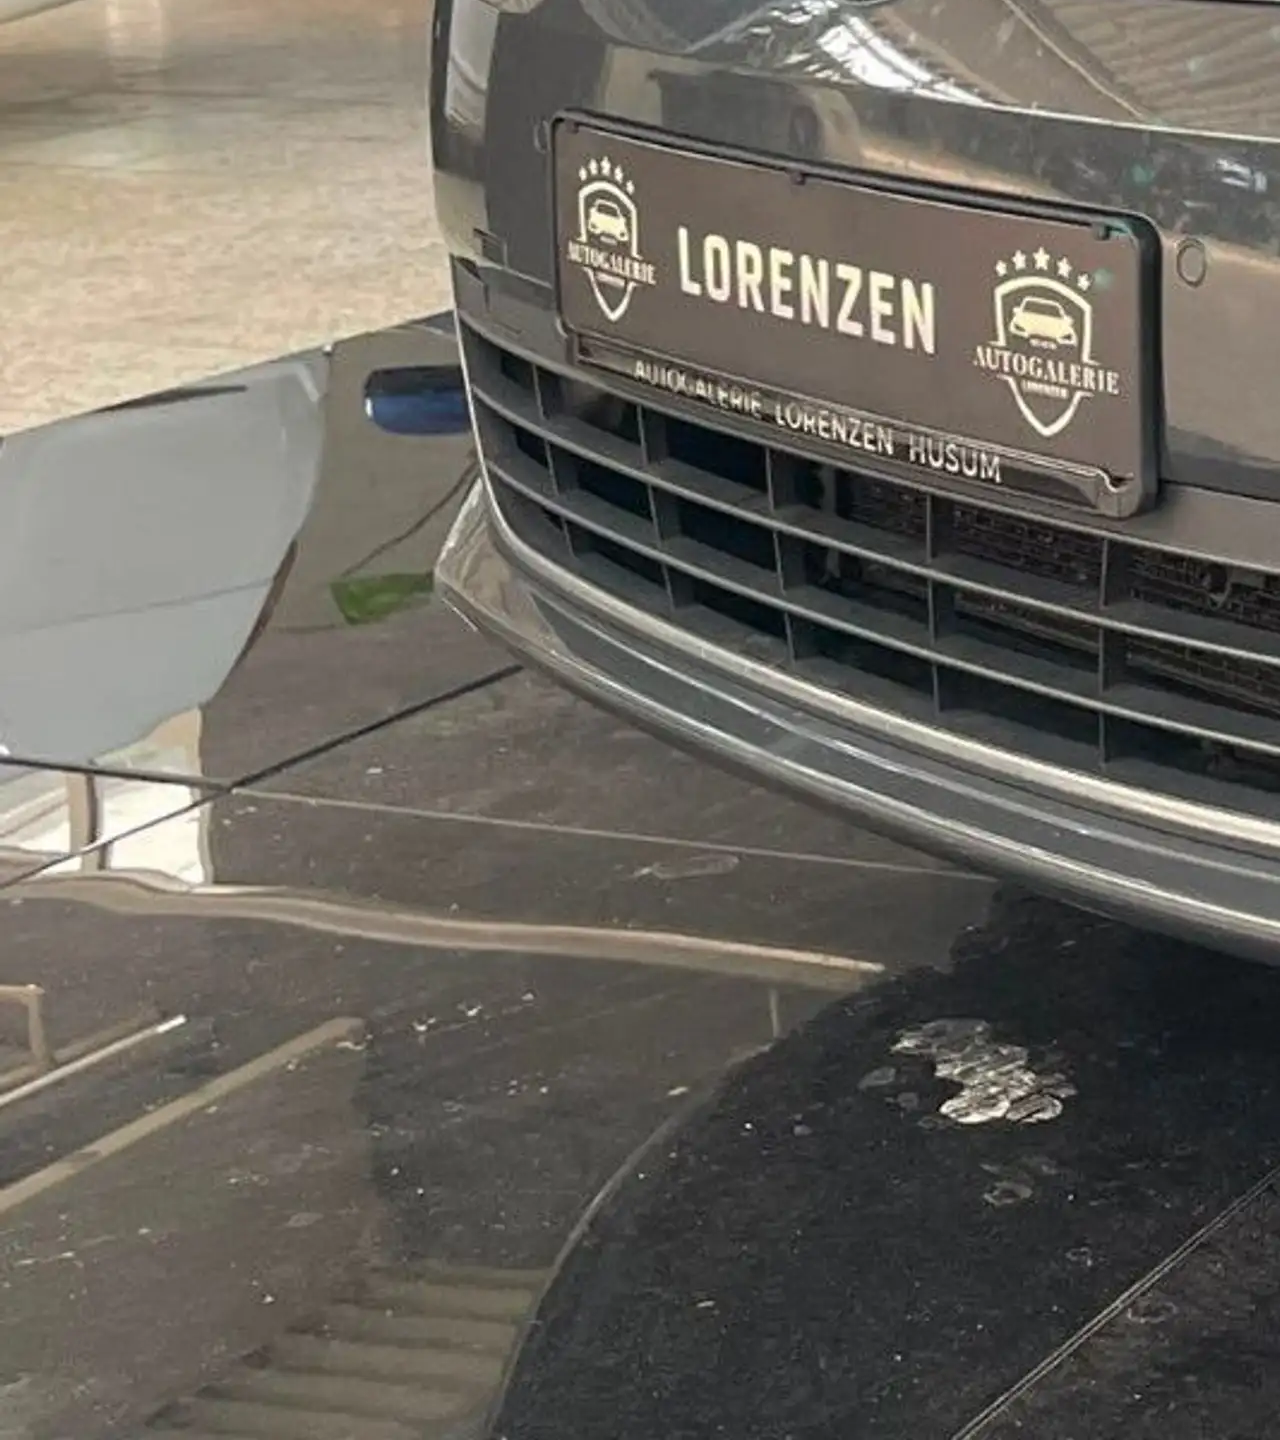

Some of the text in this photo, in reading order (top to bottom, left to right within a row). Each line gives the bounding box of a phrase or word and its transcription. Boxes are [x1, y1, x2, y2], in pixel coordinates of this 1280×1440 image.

[677, 227, 936, 354] LORENZEN
[973, 344, 1120, 395] AUTOGALERIE
[776, 402, 895, 456] LORENZEN
[909, 432, 1002, 484] HUSUM
